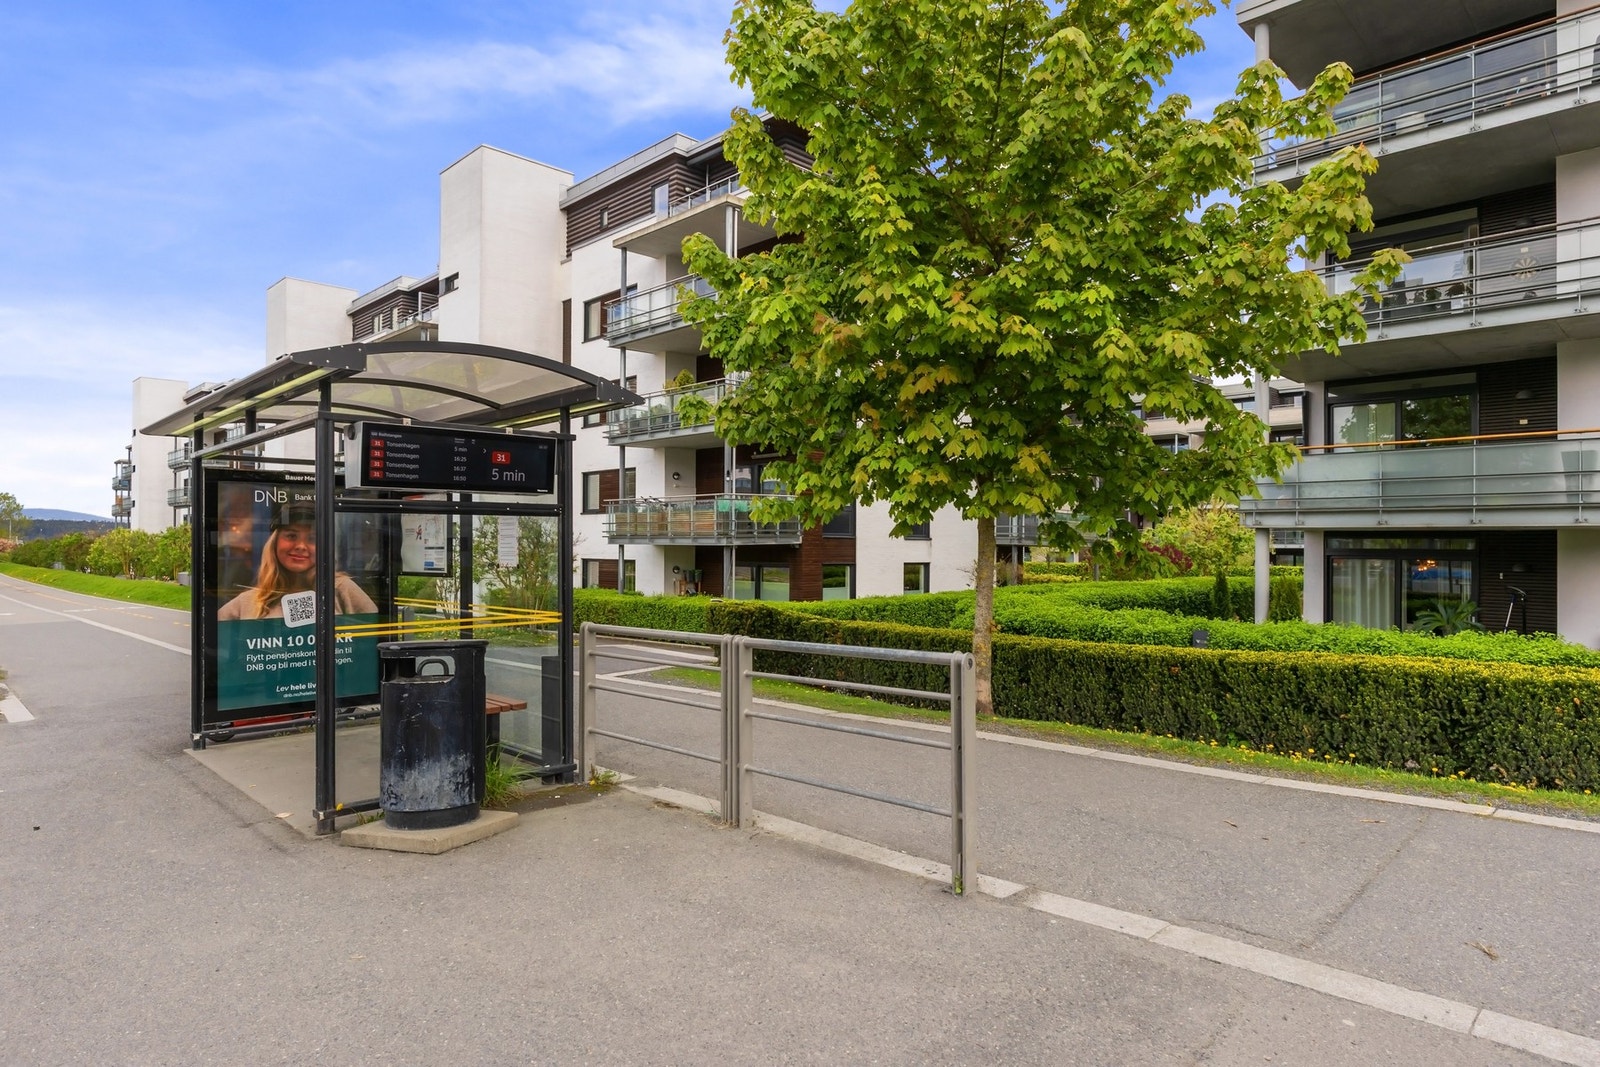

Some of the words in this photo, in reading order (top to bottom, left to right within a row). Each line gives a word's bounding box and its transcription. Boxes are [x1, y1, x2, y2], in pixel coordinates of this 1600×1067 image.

[386, 441, 420, 449] Tonsenhagen
[386, 451, 420, 459] Tonsenhagen
[496, 453, 506, 462] 31
[386, 462, 420, 470] Tonsenhagen
[492, 468, 499, 480] 5
[503, 469, 526, 482] min
[254, 486, 288, 507] DNB
[246, 636, 282, 650] VINN
[287, 635, 304, 647] 10
[336, 632, 353, 643] KR
[246, 654, 264, 662] Flytt
[266, 650, 316, 662] pensjonskont
[246, 663, 264, 672] DNB
